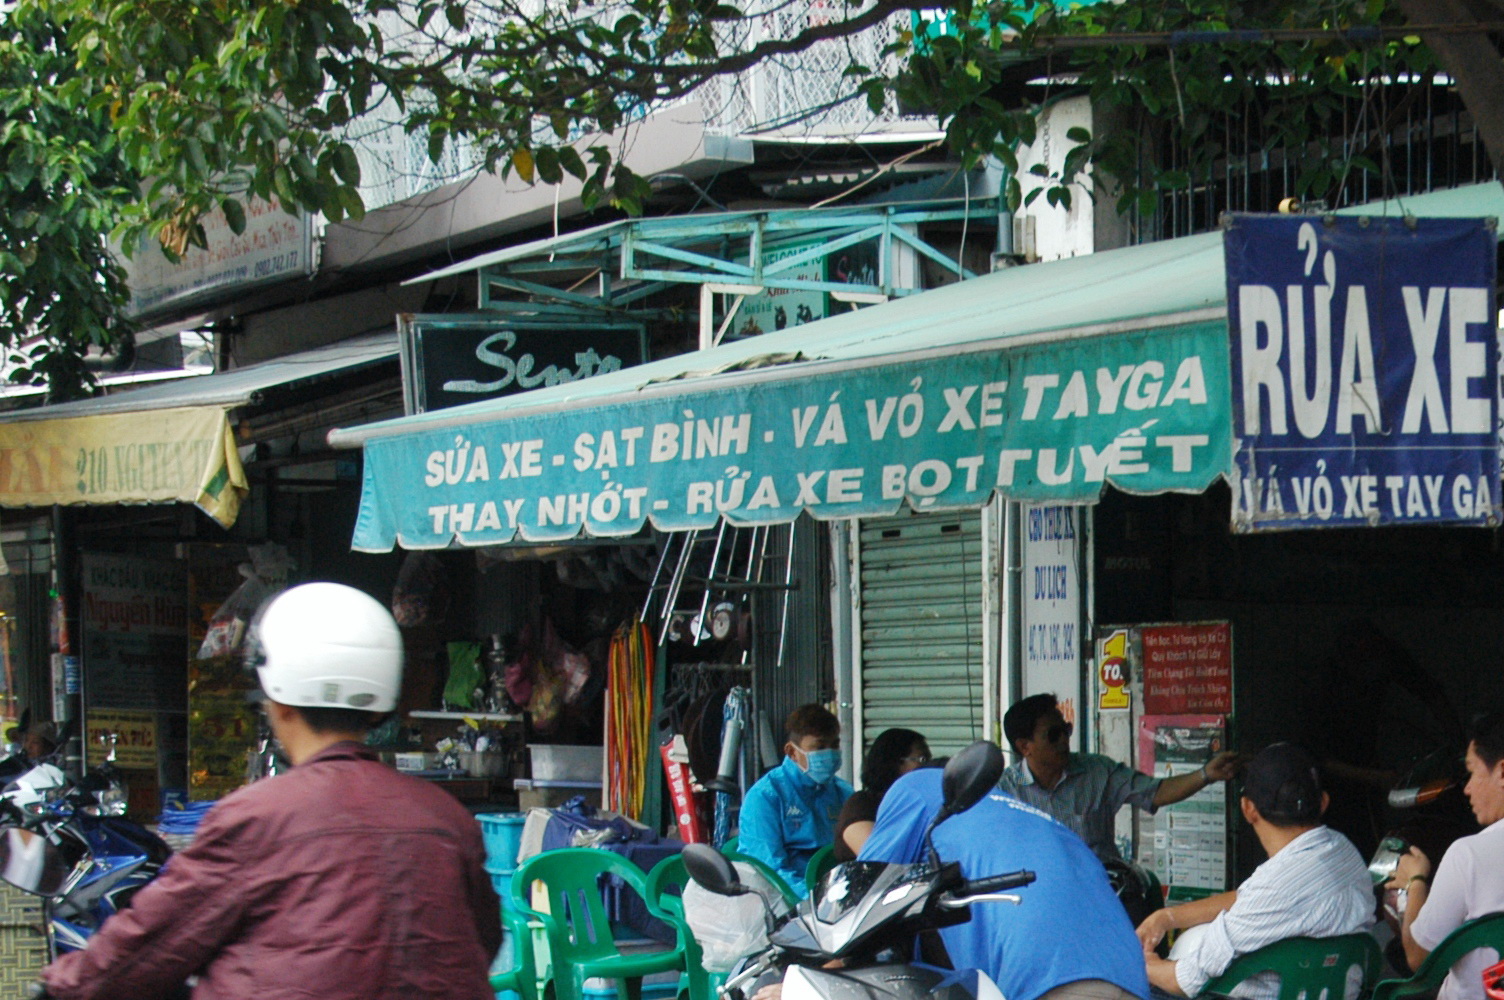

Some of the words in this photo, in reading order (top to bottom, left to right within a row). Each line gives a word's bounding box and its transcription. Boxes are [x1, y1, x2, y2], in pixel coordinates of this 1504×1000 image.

[1239, 222, 1381, 439] RỬA
[1401, 286, 1492, 434] XE
[424, 435, 490, 487] SỬA
[499, 439, 543, 480] XE
[573, 427, 644, 480] SẠT
[650, 409, 752, 463] BÌNH
[792, 391, 848, 448] VÁ
[865, 376, 924, 440] VỎ
[937, 381, 1008, 433] XE
[1021, 356, 1207, 421] TAYGA
[428, 500, 524, 535] THAY
[538, 480, 648, 527] NHỚT
[686, 465, 780, 514] RỬA
[793, 467, 864, 505] XE
[882, 455, 984, 506] BỌT
[1243, 464, 1284, 518] VÁ
[1291, 459, 1334, 520] VỎ
[1341, 475, 1378, 519] XE
[1386, 474, 1444, 518] TAY
[1452, 473, 1492, 519] GA
[1034, 565, 1046, 600] DU
